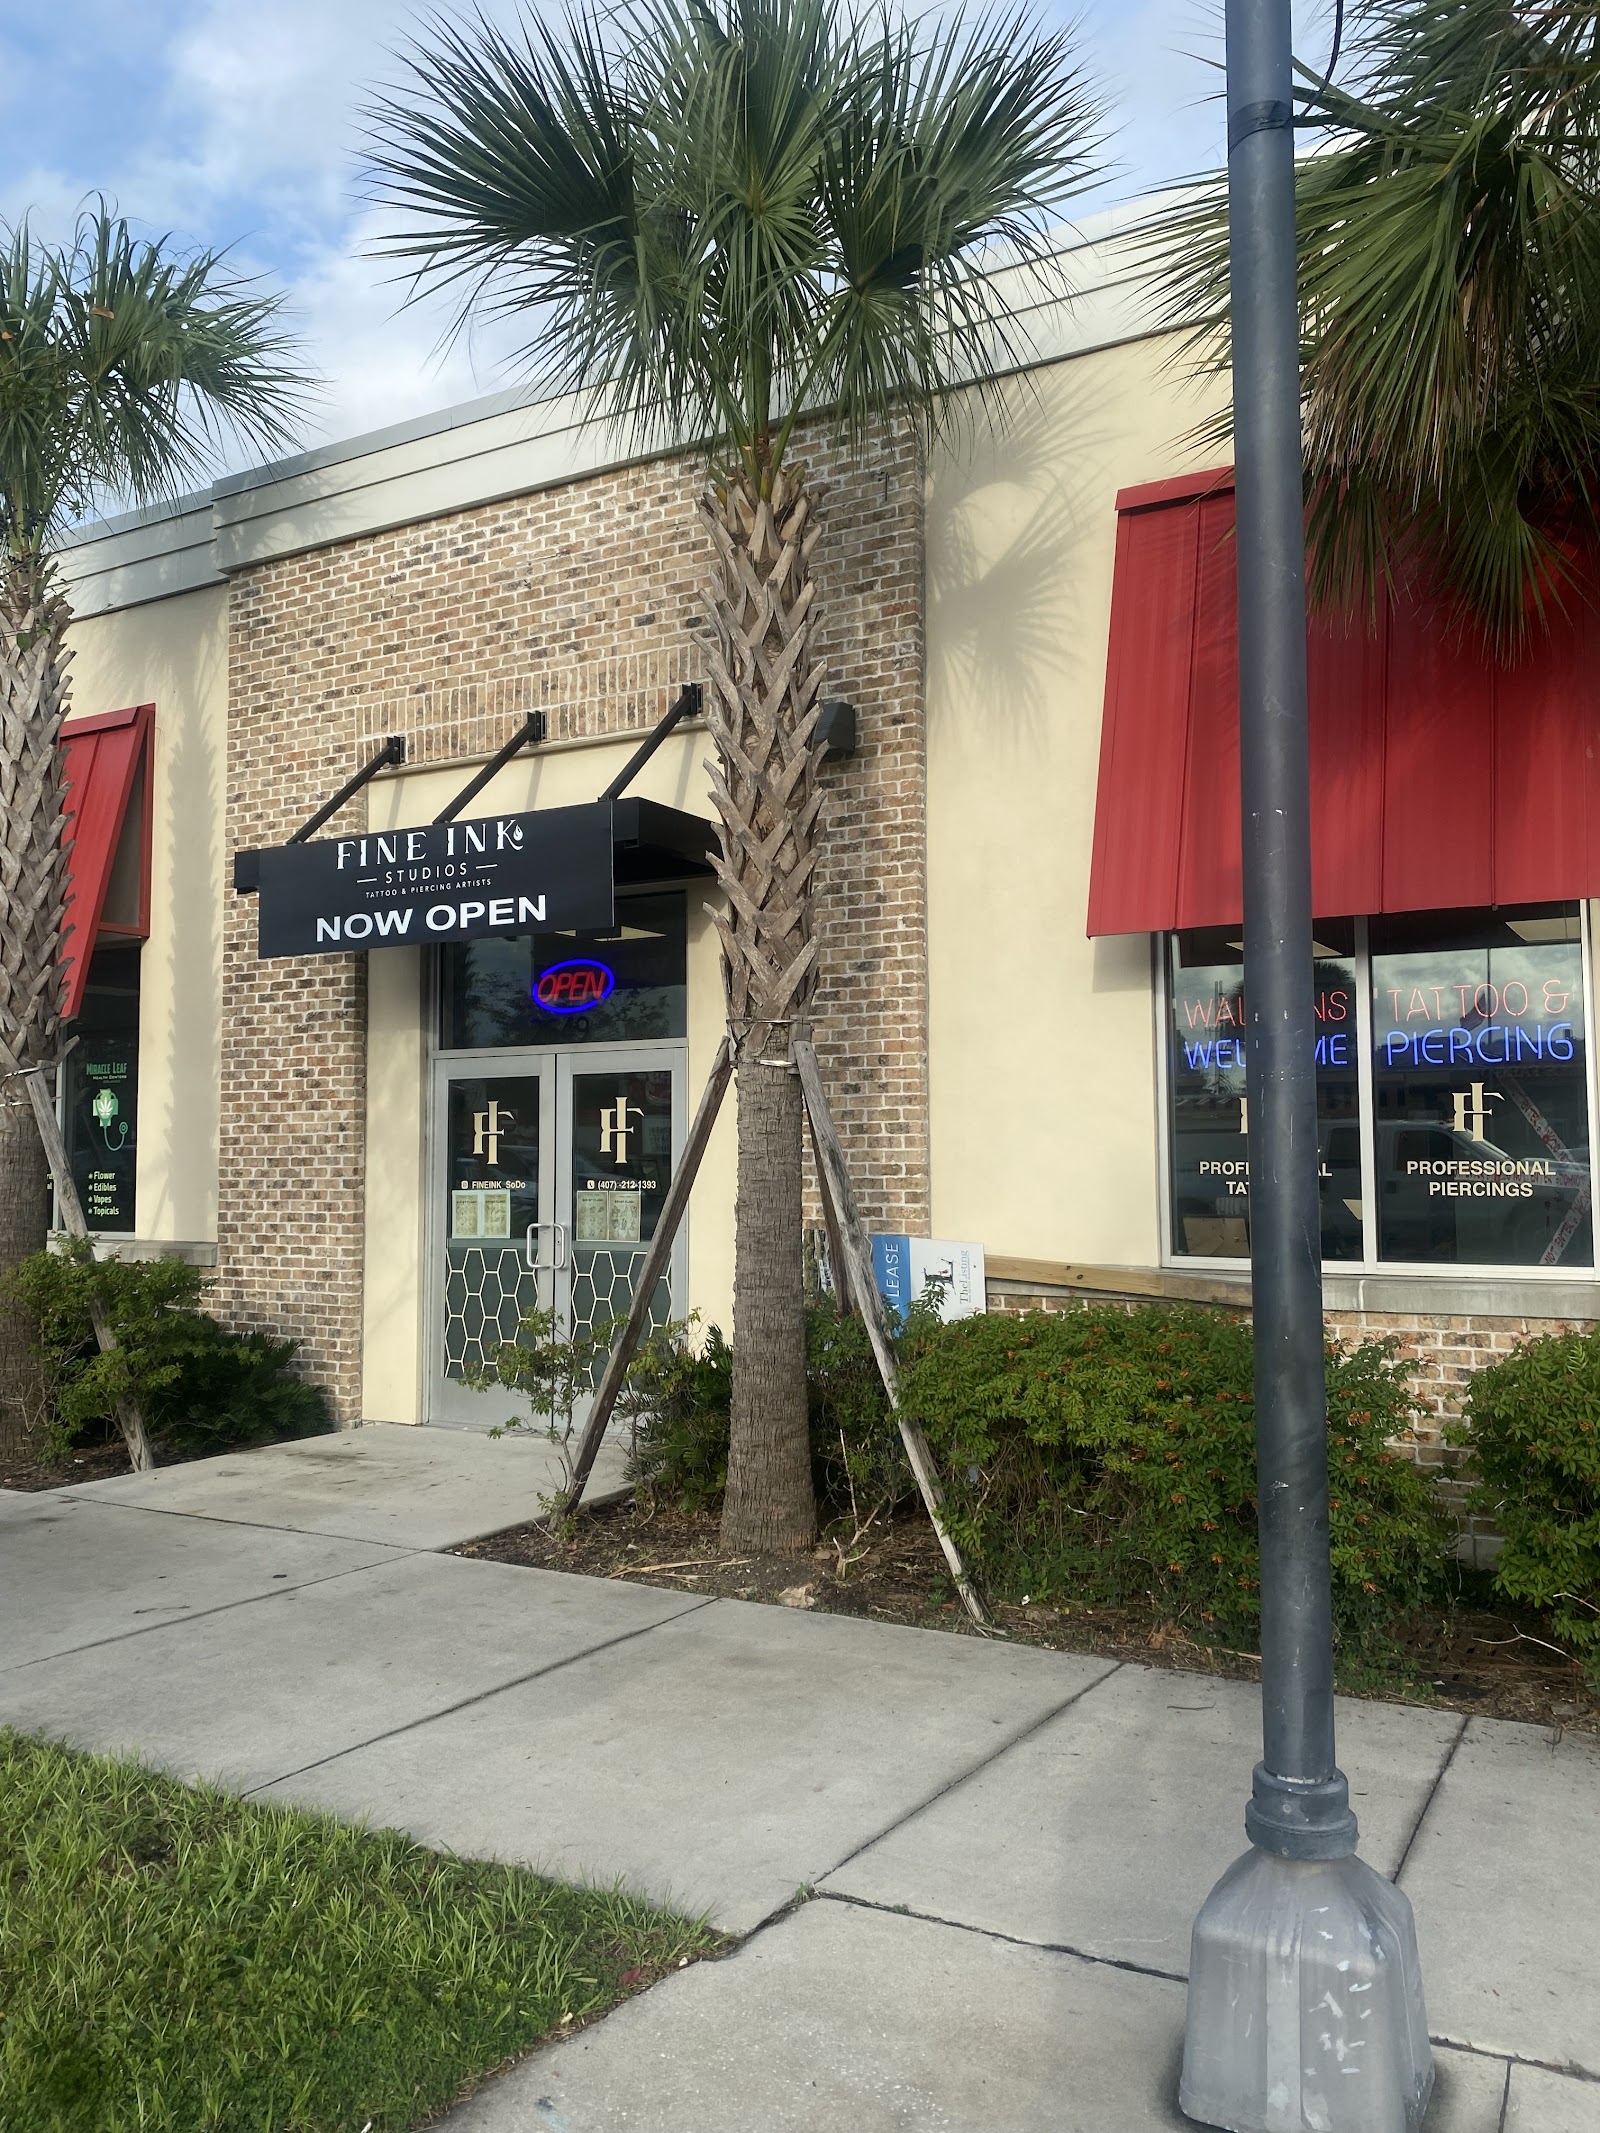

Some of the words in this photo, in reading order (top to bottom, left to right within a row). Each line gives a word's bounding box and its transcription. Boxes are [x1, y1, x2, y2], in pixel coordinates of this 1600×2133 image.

[337, 831, 427, 870] FINE
[446, 819, 524, 857] INK
[385, 862, 467, 884] STUDIOS
[365, 889, 398, 899] TATTOO
[401, 887, 407, 895] &
[411, 882, 452, 894] PIERCING
[455, 878, 492, 889] ARTISTS
[316, 908, 413, 943] NOW
[426, 894, 547, 932] OPEN
[538, 971, 606, 1003] OPEN
[1387, 981, 1528, 1023] TATTOO
[1543, 979, 1571, 1015] &
[1184, 996, 1247, 1029] WAL
[1387, 1022, 1574, 1066] PIERCING
[112, 1062, 128, 1074] LEAF
[94, 1171, 116, 1180] Flower
[1407, 1160, 1556, 1177] PROFESSIONAL
[94, 1183, 117, 1191] Edibles
[472, 1180, 502, 1189] FINEINK
[505, 1180, 526, 1189] SoDo
[1429, 1181, 1533, 1197] PIERCINGS
[94, 1194, 112, 1204] Vapes
[94, 1206, 119, 1216] Topicals
[886, 1242, 899, 1298] LEASE
